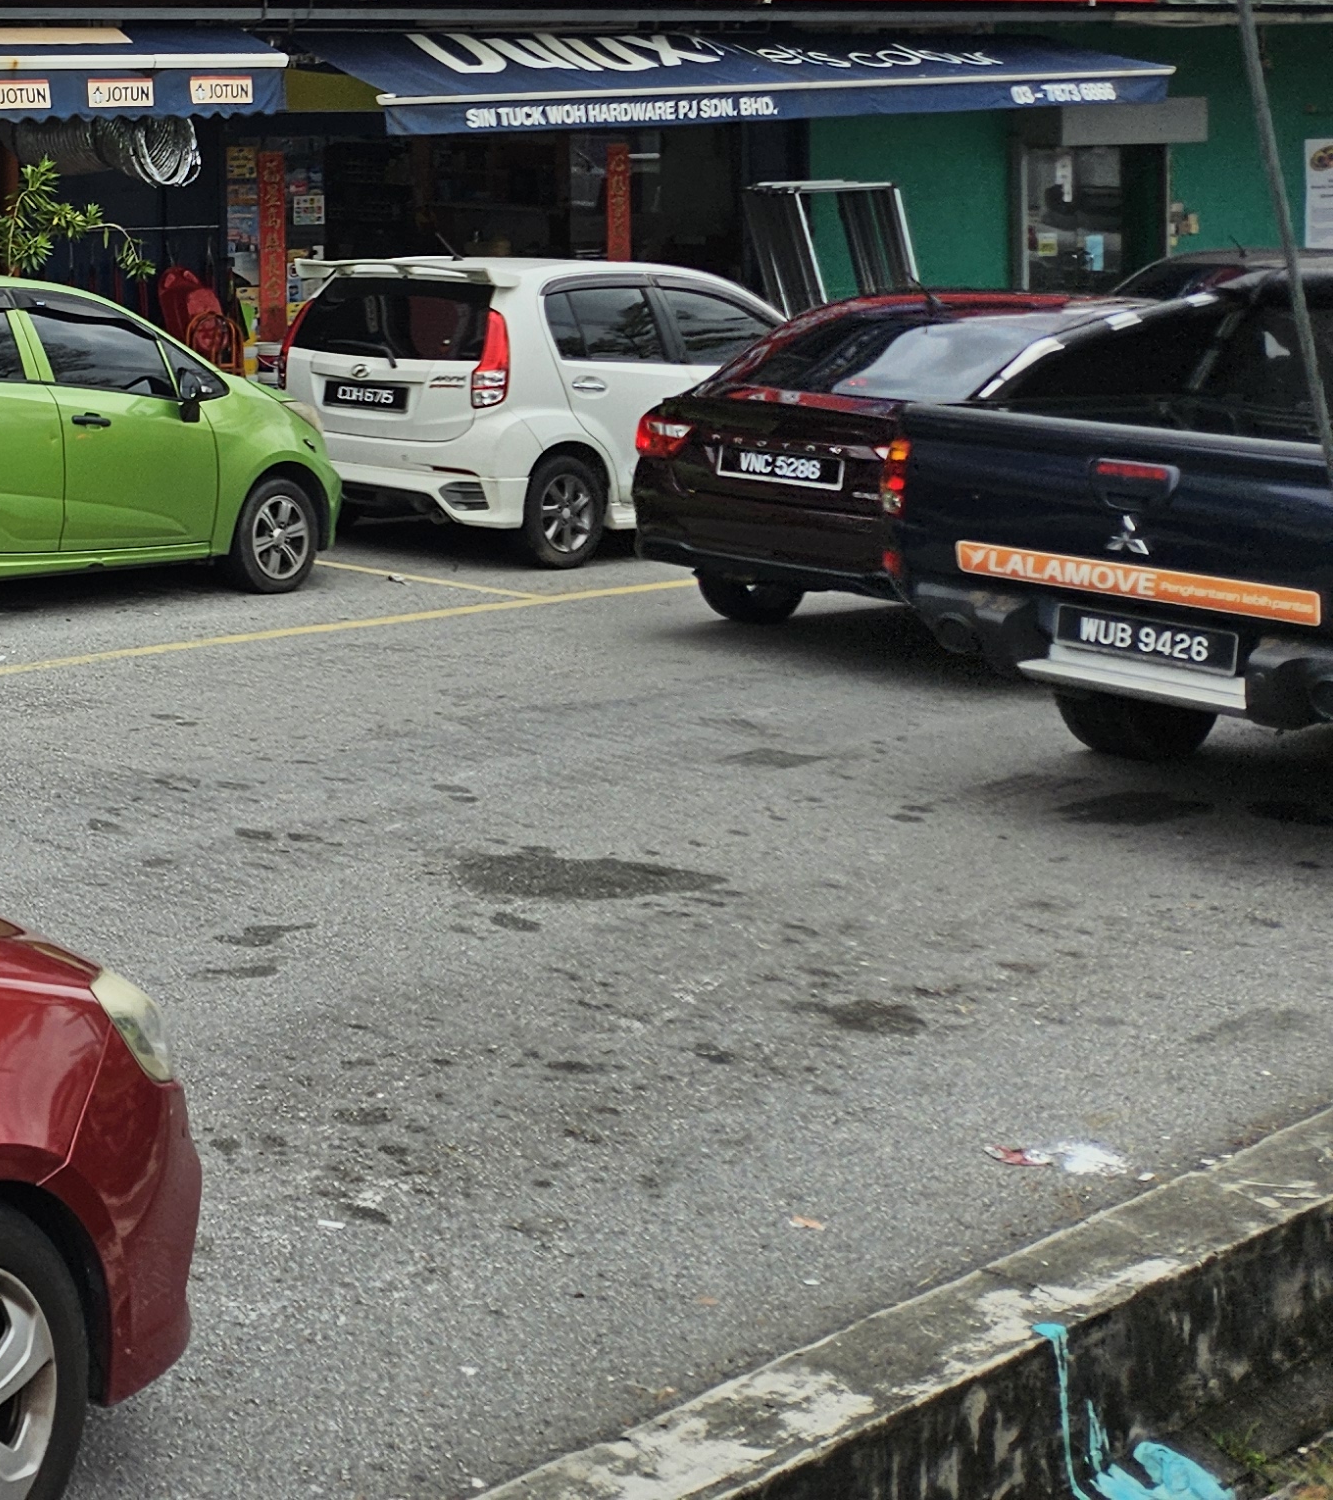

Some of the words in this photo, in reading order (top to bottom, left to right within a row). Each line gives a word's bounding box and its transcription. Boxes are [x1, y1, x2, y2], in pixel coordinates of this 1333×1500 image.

[209, 84, 249, 100] JOTUN
[465, 107, 497, 128] SIN
[498, 105, 547, 127] TUCK
[548, 104, 587, 124] WOH
[588, 101, 677, 122] HARDWARE
[678, 100, 698, 120] PJ
[699, 99, 737, 119] SDN.
[739, 97, 778, 117] BHD.
[740, 451, 773, 473] VNC
[774, 457, 821, 479] 5286
[987, 549, 1157, 596] LALAMOVE
[1080, 616, 1132, 649] WUB
[1137, 626, 1209, 662] 9426
